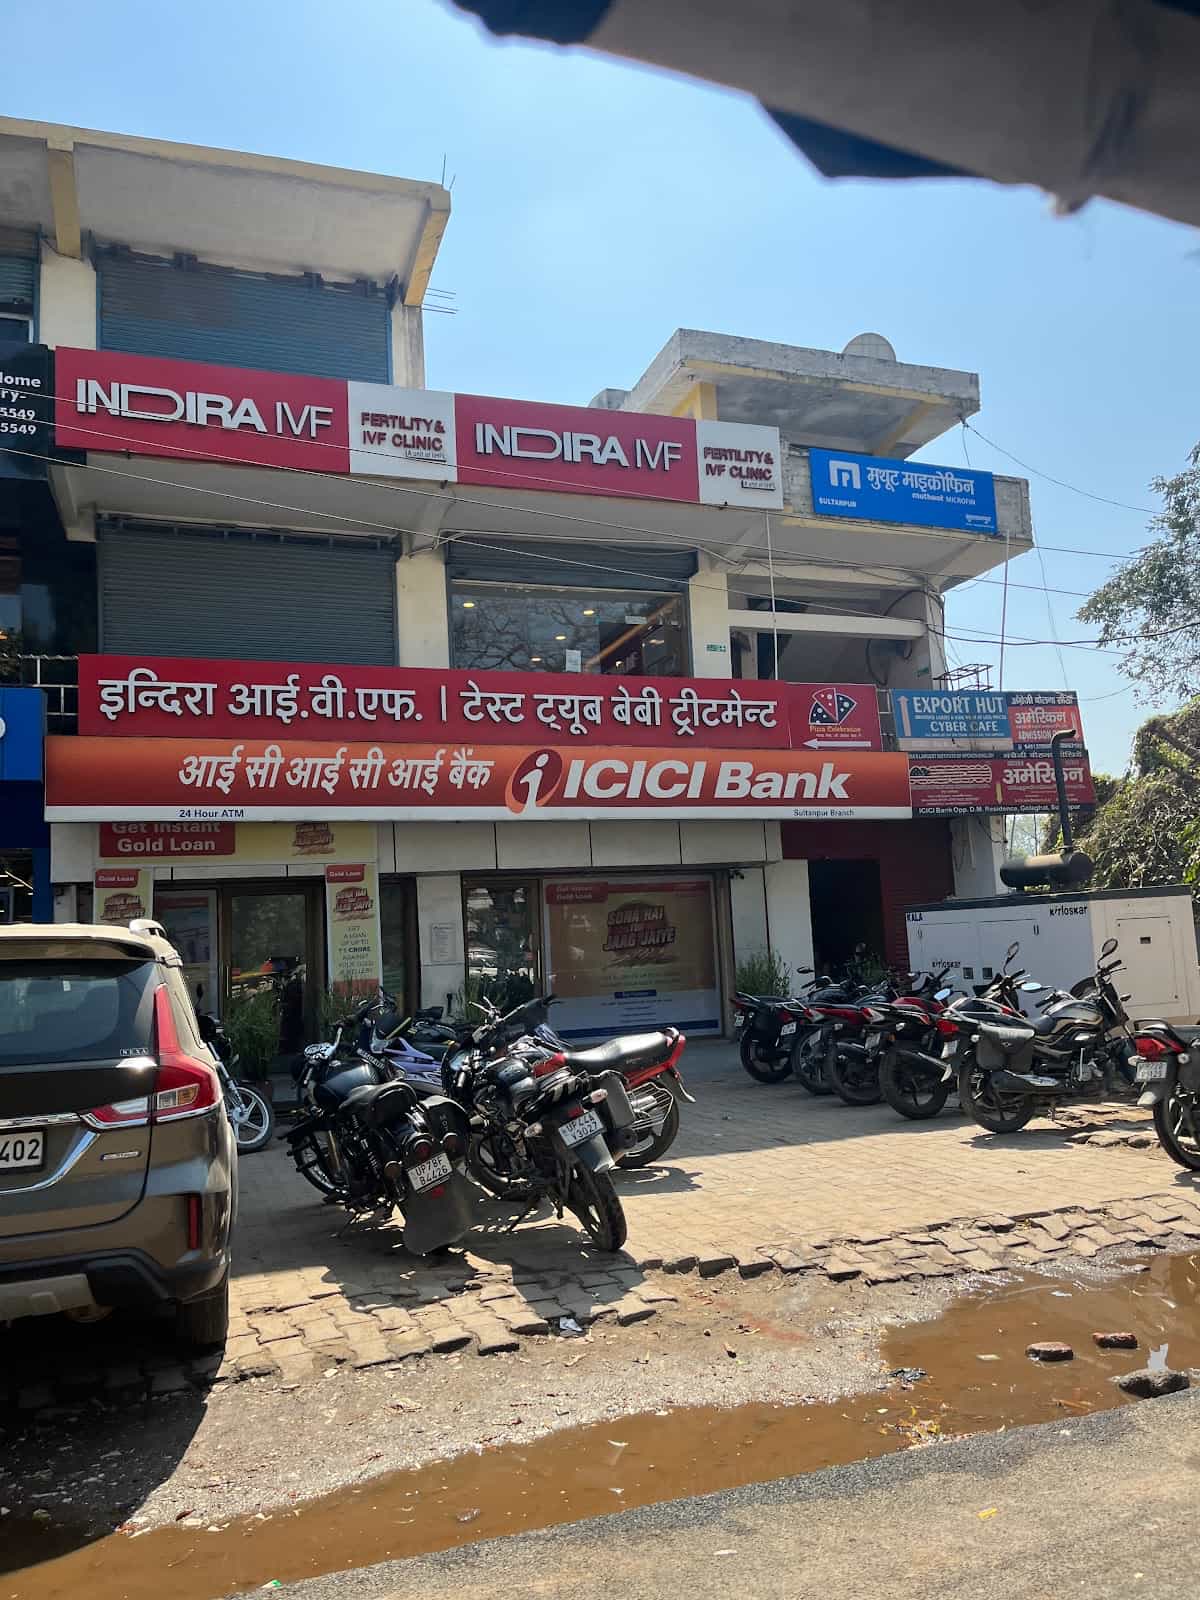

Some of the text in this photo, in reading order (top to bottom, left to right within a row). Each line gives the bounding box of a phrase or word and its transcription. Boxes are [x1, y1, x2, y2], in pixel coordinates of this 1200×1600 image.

[76, 378, 334, 438] INDIRA IVF
[362, 430, 443, 451] IVF CLINIC
[474, 422, 682, 472] INDIRA IVF
[705, 463, 773, 480] IVF CLINIC
[866, 466, 900, 493] मुथूट
[97, 668, 218, 721] इन्दिरा
[227, 674, 424, 723] आई.वी.एफ.
[459, 680, 525, 723] टेस्ट
[611, 685, 663, 726] बेबी
[669, 687, 778, 736] ट्रीटमेन्ट
[912, 696, 1004, 714] EXPORT HUT
[930, 720, 999, 732] CYBER CAFE
[178, 745, 495, 795] आई सी आई सी आई बैंक
[563, 759, 706, 800] ICICI
[714, 761, 855, 800] Bank
[179, 809, 245, 818] 24 Hour ATM
[830, 808, 855, 817] Branch
[117, 838, 216, 852] Gold Loan
[0, 1139, 40, 1162] 402
